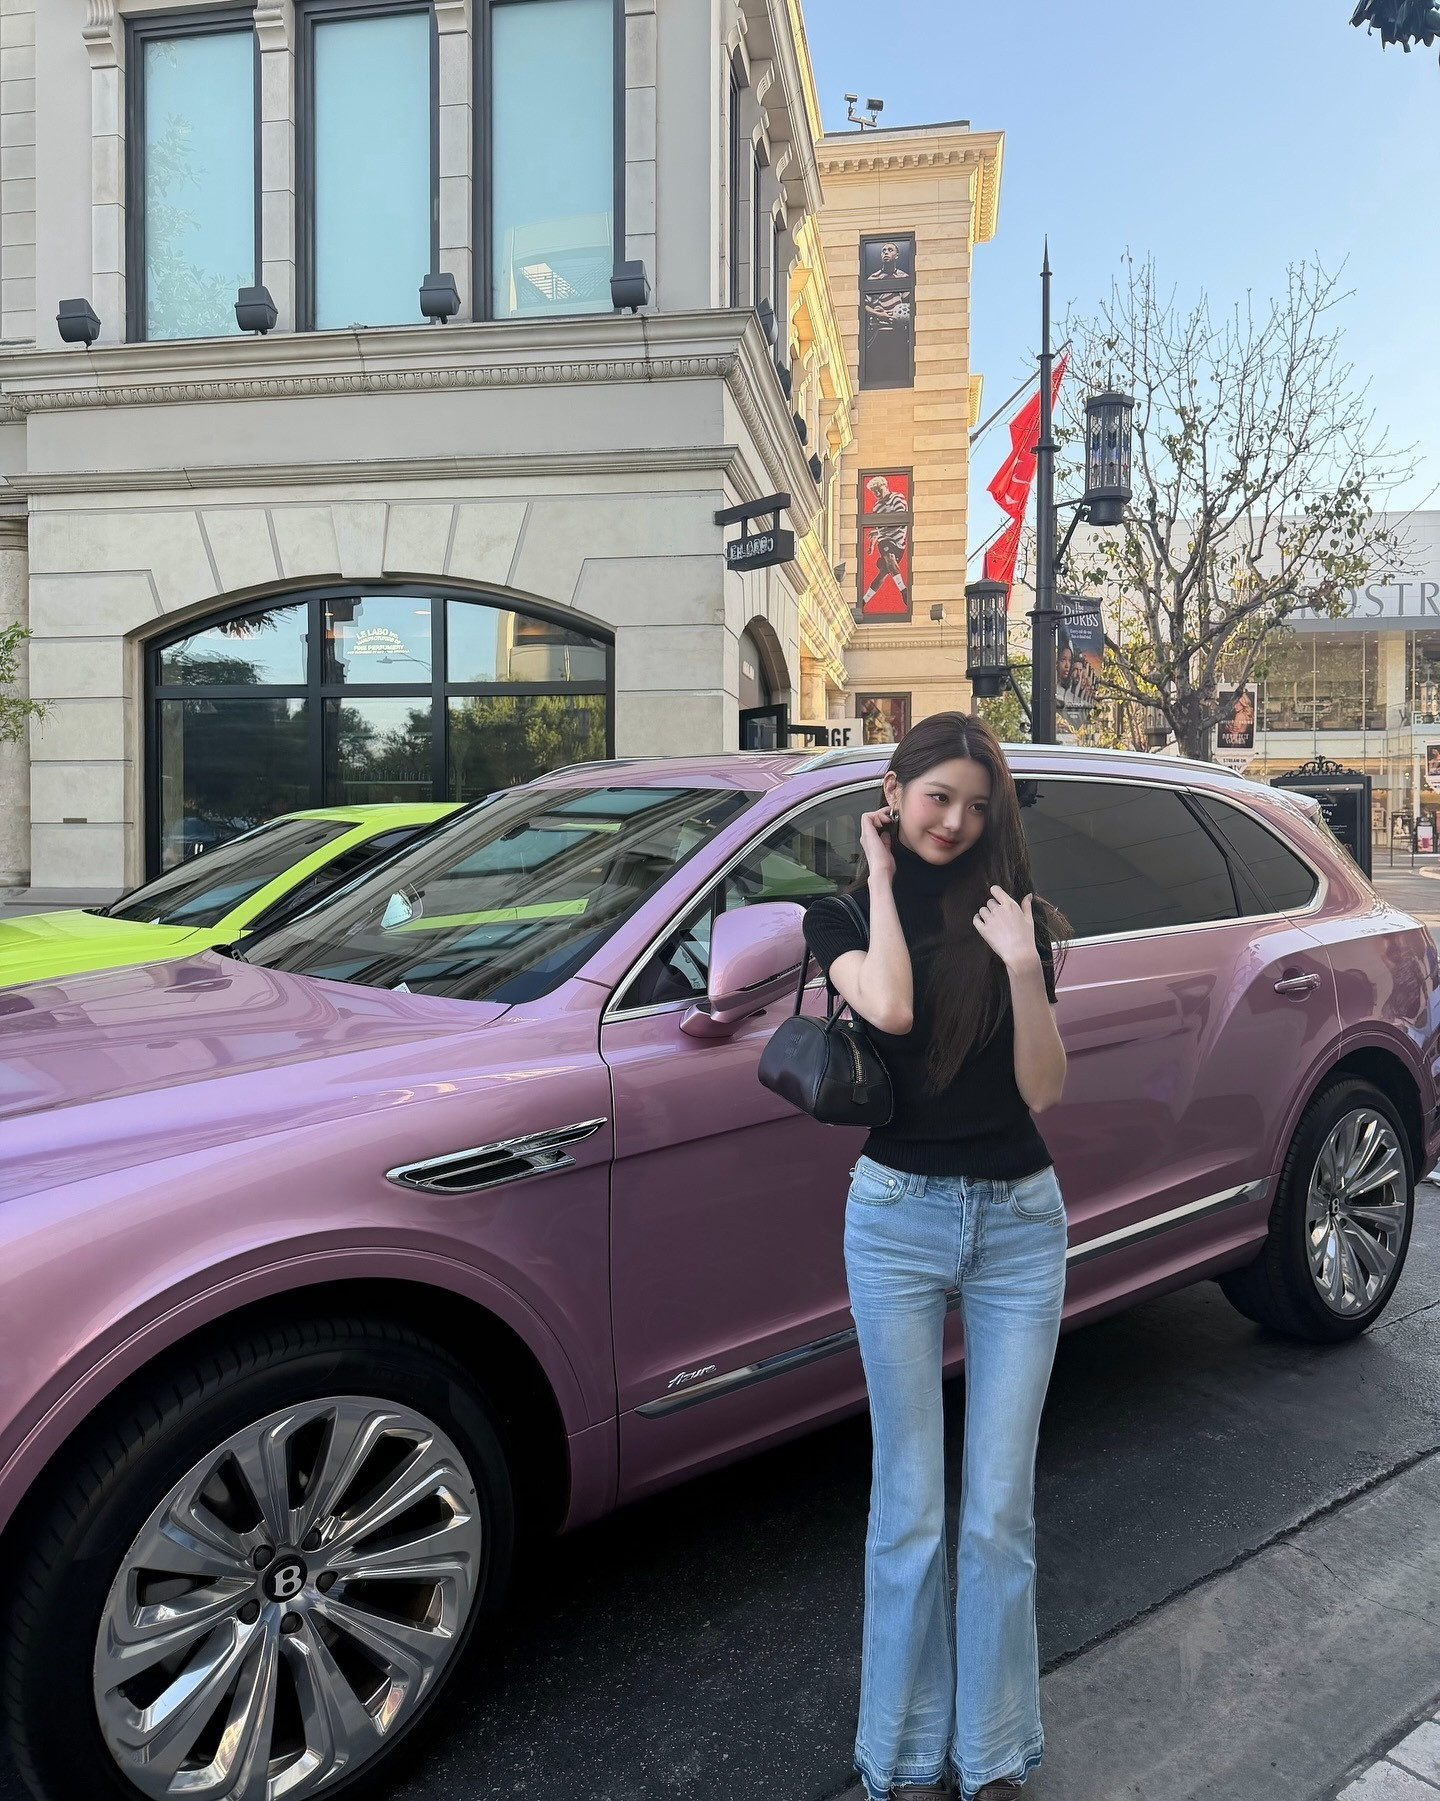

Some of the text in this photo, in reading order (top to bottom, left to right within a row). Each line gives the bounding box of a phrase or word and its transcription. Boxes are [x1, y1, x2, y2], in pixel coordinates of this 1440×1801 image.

[1074, 601, 1084, 611] The
[356, 630, 367, 640] LE
[367, 628, 389, 636] LABO
[274, 1565, 302, 1597] B
